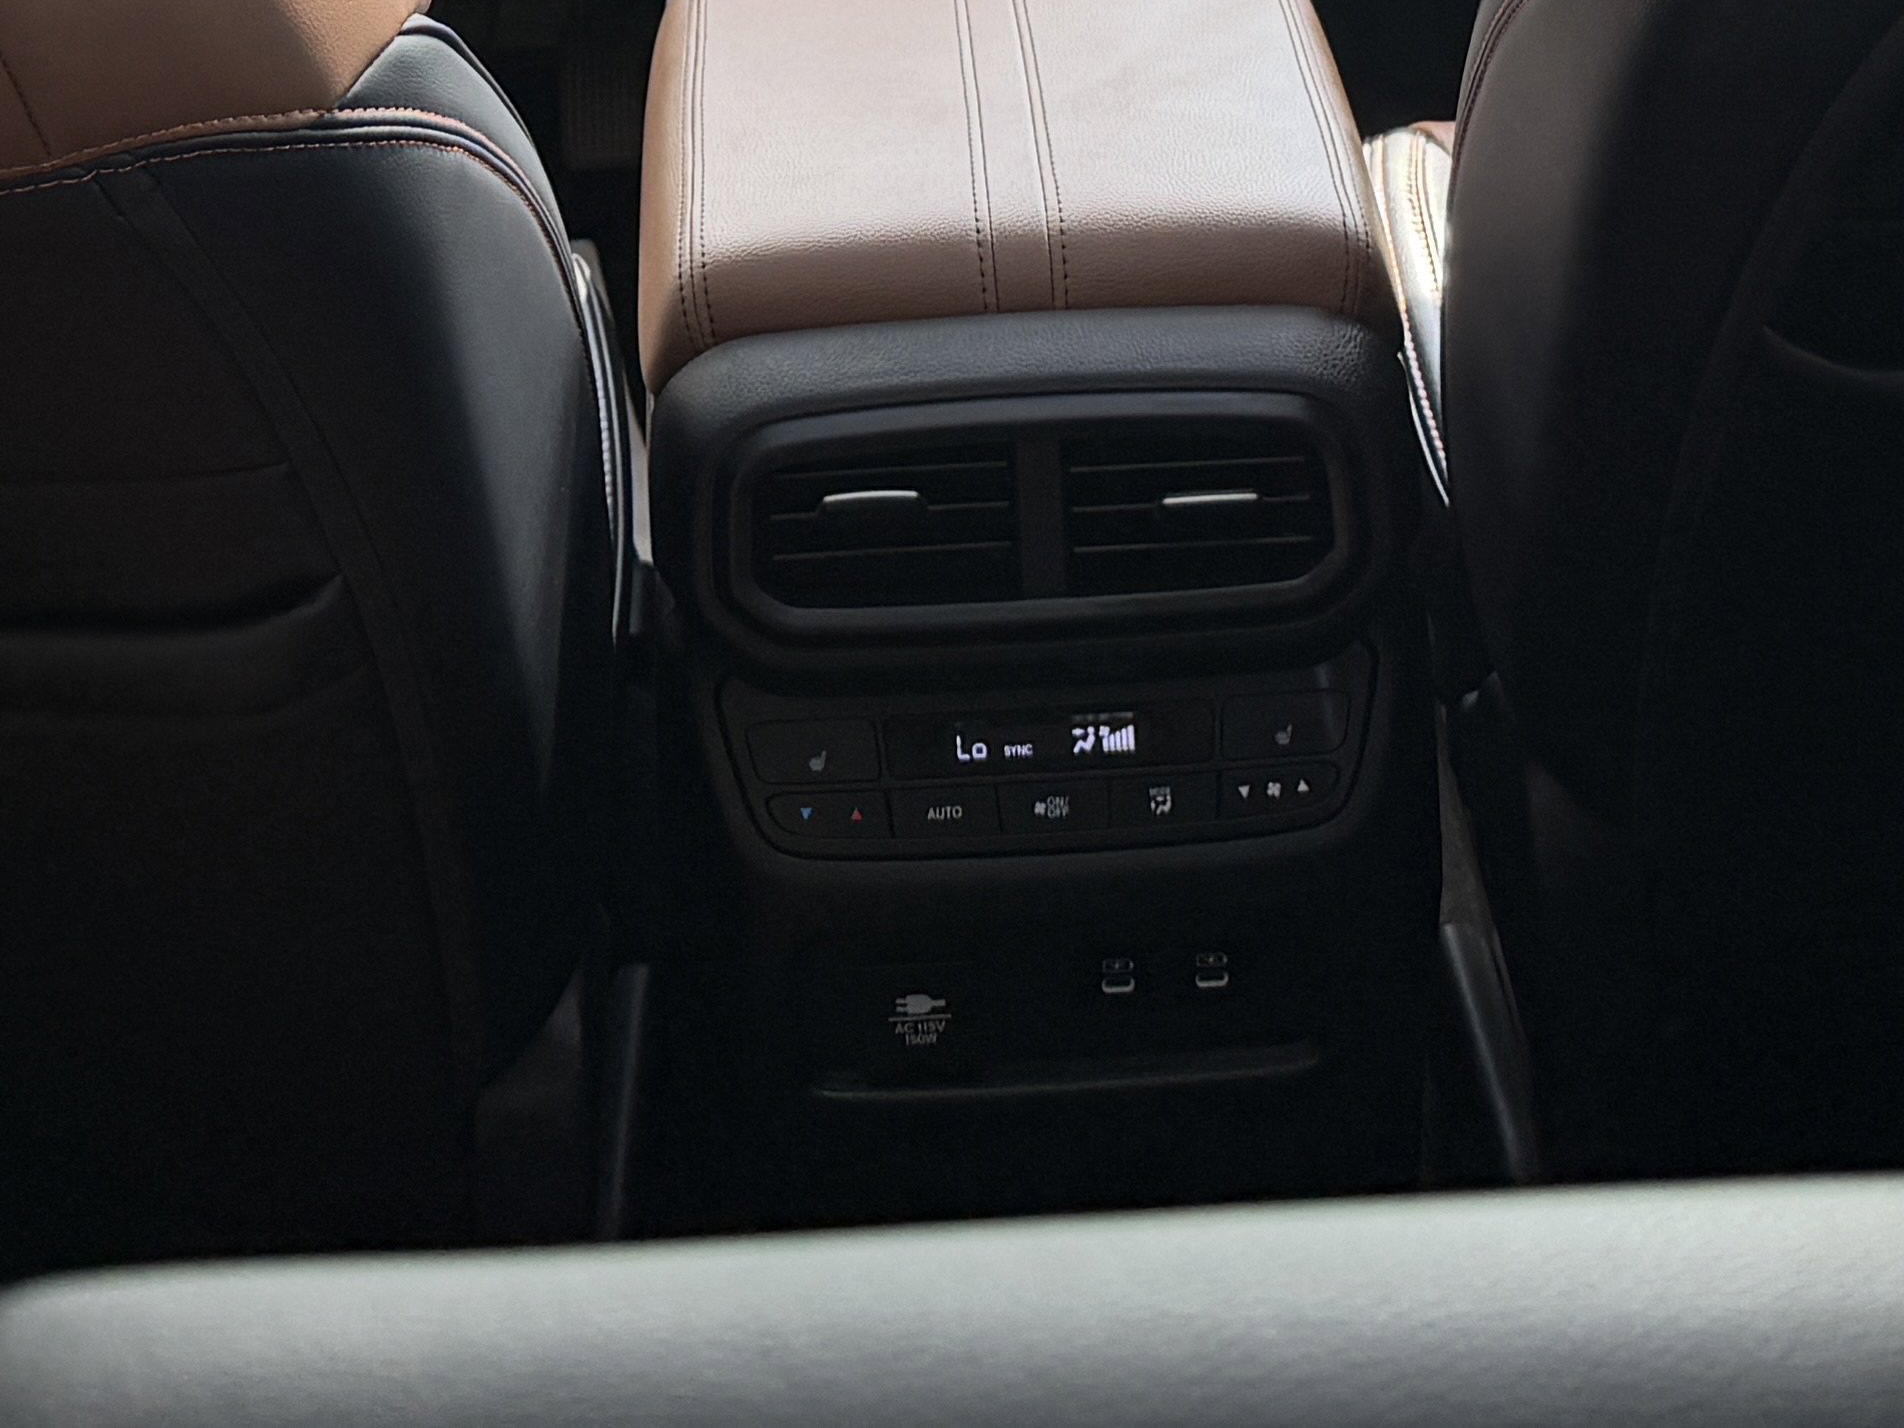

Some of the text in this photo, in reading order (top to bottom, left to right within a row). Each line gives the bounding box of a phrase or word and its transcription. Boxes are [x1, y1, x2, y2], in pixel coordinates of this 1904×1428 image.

[956, 734, 1034, 761] Lo SYNC
[927, 805, 963, 820] AUTO
[895, 1022, 914, 1034] AC
